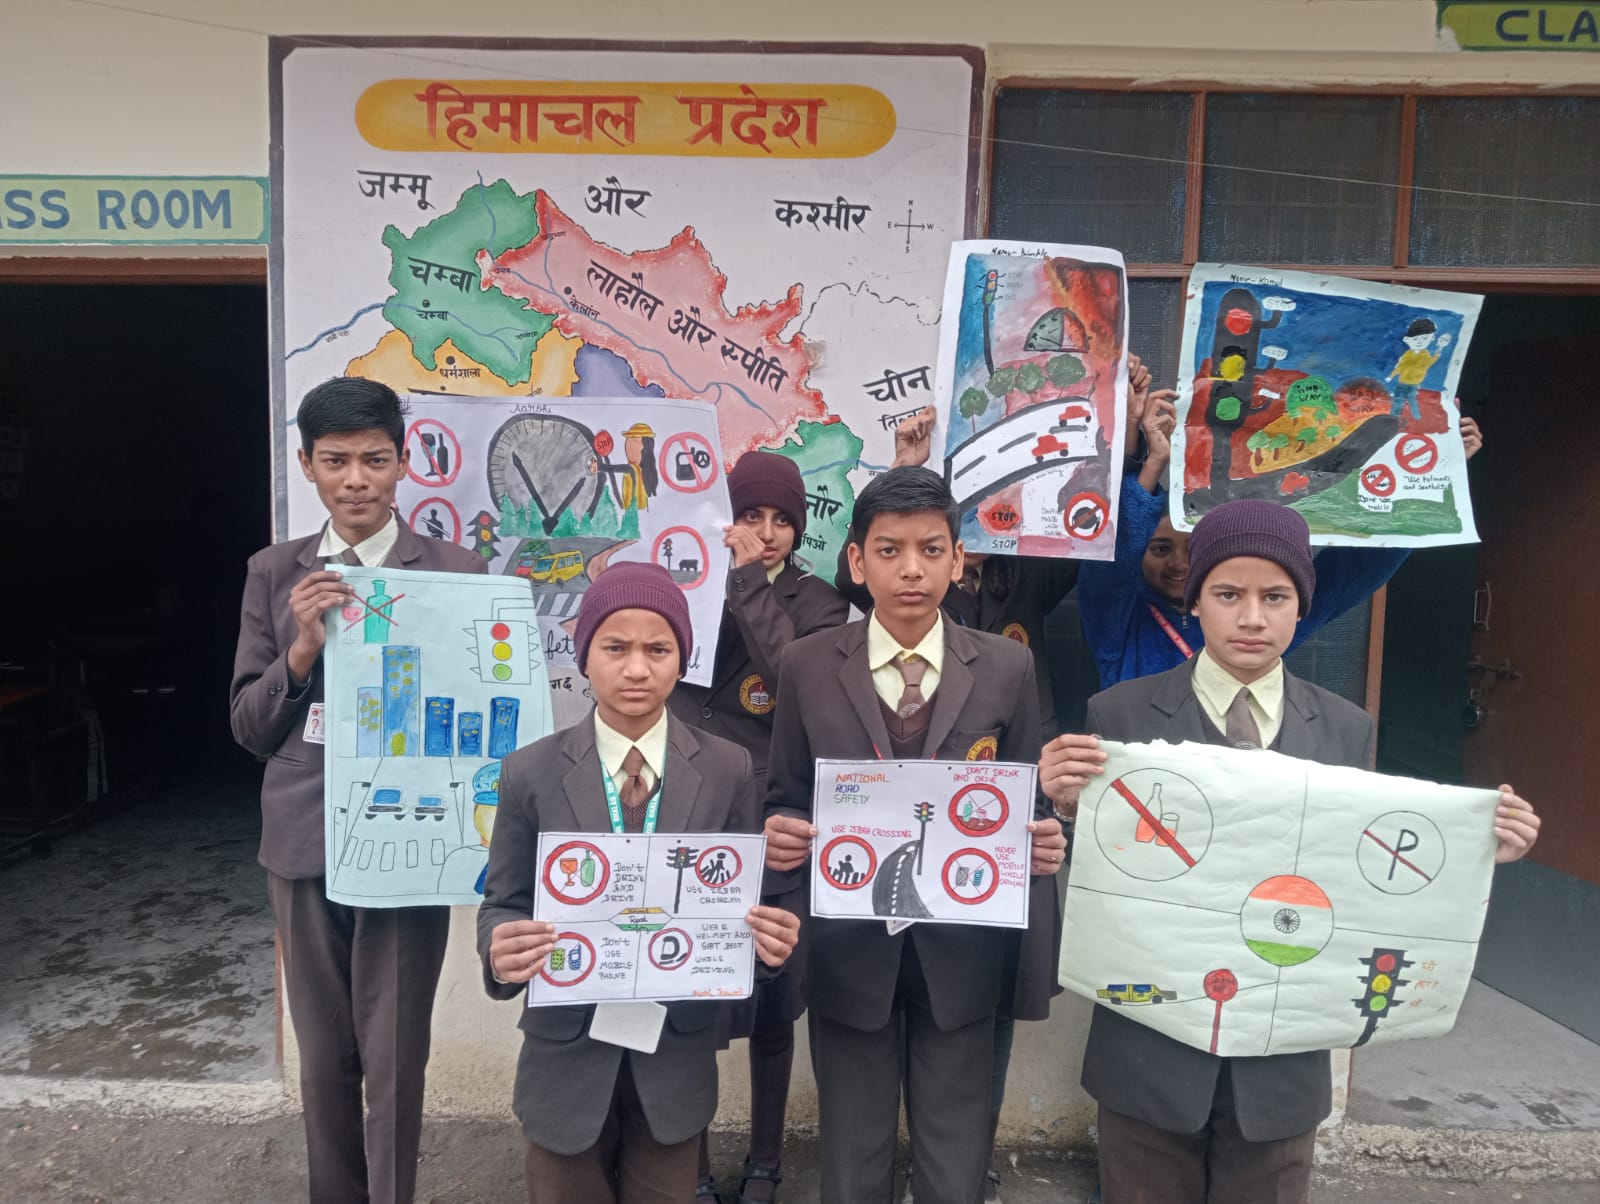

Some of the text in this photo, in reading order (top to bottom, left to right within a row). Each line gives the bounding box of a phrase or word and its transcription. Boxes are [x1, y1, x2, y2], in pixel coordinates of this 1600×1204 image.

[1495, 9, 1600, 43] CLA
[414, 82, 827, 153] हिमाचल प्रदेश
[357, 170, 872, 234] जम्मू और कश्मीर
[0, 189, 232, 229] SS ROOM
[408, 256, 477, 293] चम्बा
[416, 310, 449, 321] चम्बा
[587, 259, 789, 393] लाहौल और स्पीति
[439, 366, 481, 379] धर्मशाला
[862, 365, 931, 403] चीन
[991, 510, 1017, 522] STOP
[992, 539, 1017, 549] STOP
[543, 629, 576, 663] fet
[965, 766, 1020, 778] DON'T DRINK
[836, 773, 890, 784] NATIONAL
[953, 773, 997, 784] AND DRIVE
[835, 784, 860, 793] ROAD
[833, 794, 870, 804] SAFETY
[831, 825, 912, 838] USE ZEBRA CROSSING
[995, 846, 1016, 855] NEVER
[996, 853, 1011, 862] USE
[613, 862, 645, 872] Don't
[998, 861, 1024, 870] MOBILE
[614, 873, 645, 883] DRINK
[612, 884, 639, 892] AND
[686, 886, 703, 894] USE
[601, 894, 639, 904] DRIVE
[629, 915, 648, 924] Road
[696, 932, 731, 940] HELMET
[601, 937, 631, 947] Don't
[604, 950, 622, 958] USE
